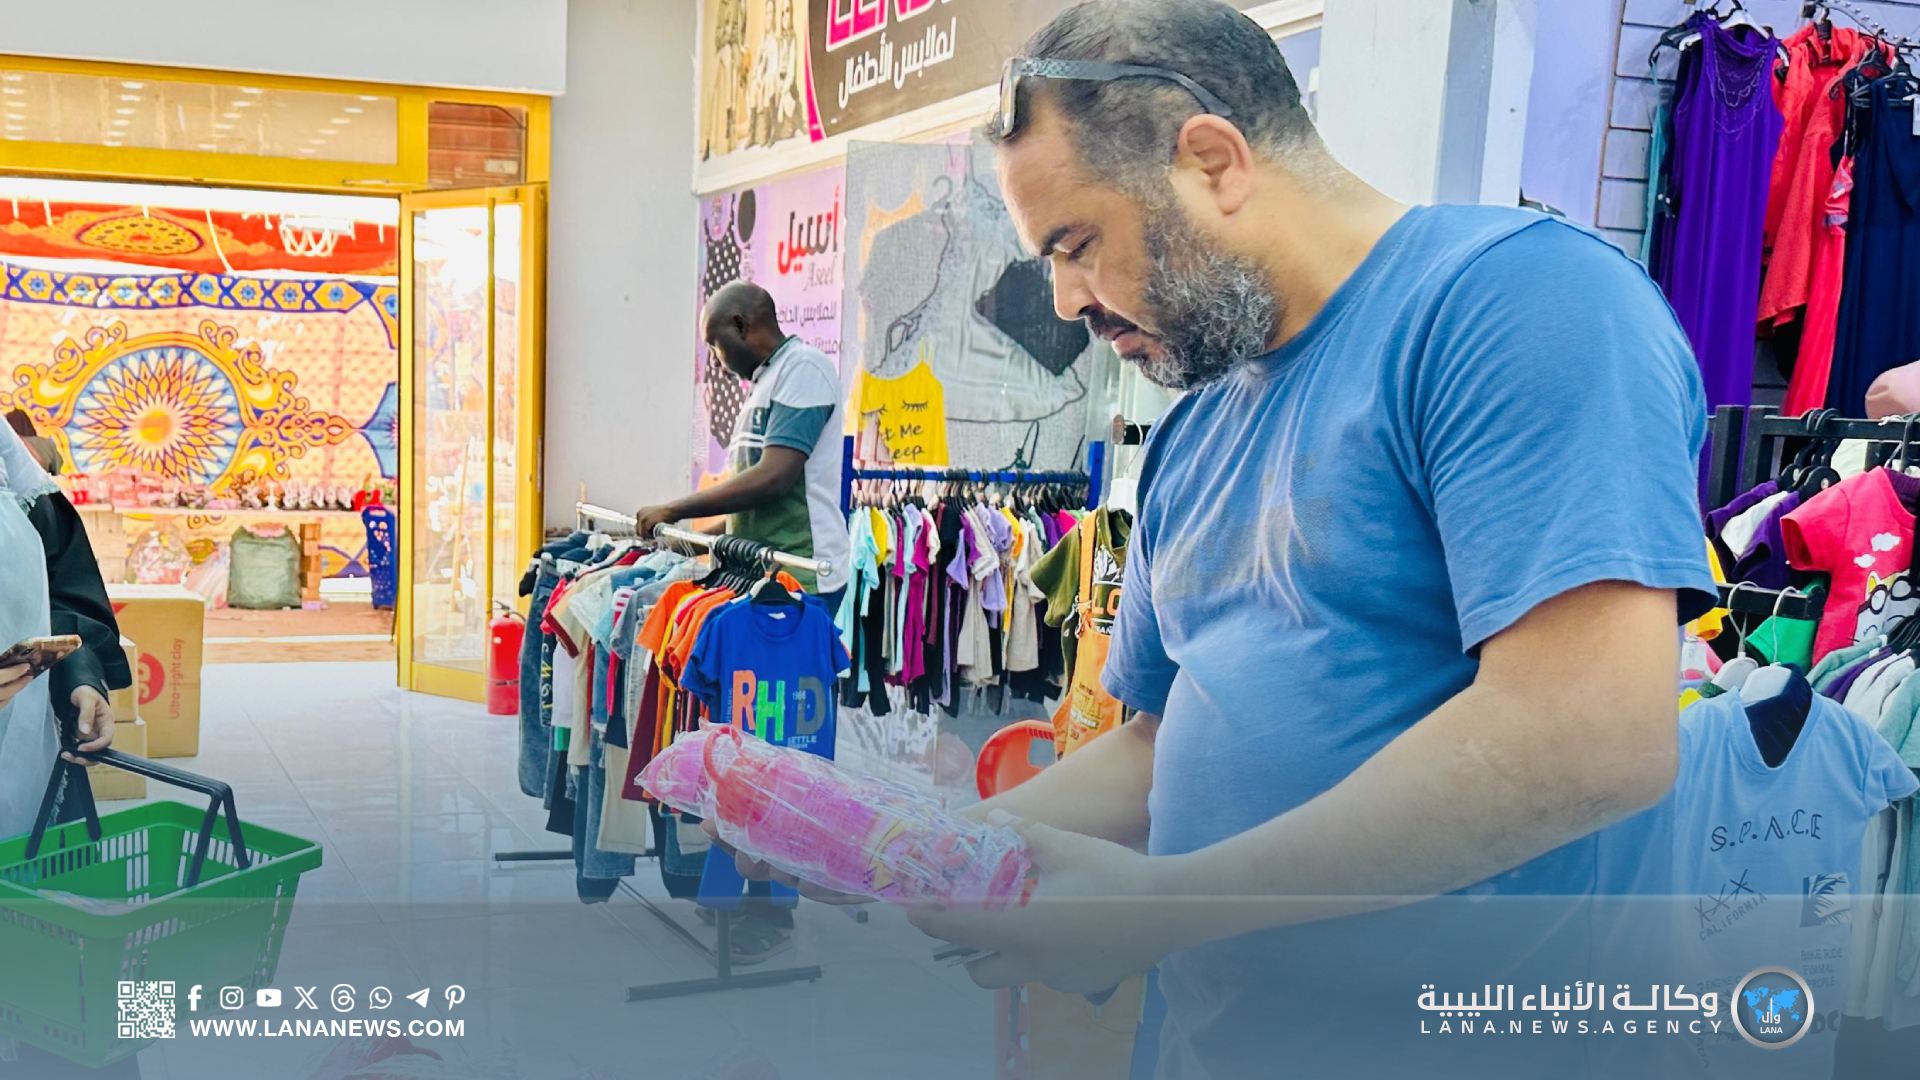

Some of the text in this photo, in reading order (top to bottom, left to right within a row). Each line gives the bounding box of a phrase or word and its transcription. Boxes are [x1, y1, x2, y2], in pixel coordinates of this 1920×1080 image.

[838, 32, 893, 109] الأطفال
[894, 16, 957, 90] لملابس
[777, 185, 840, 275] أسيل
[899, 422, 924, 438] Me
[892, 444, 925, 461] eep
[170, 636, 185, 660] clay
[1698, 892, 1768, 942] CALIFORNIA
[1800, 947, 1843, 961] BIKE RIDE
